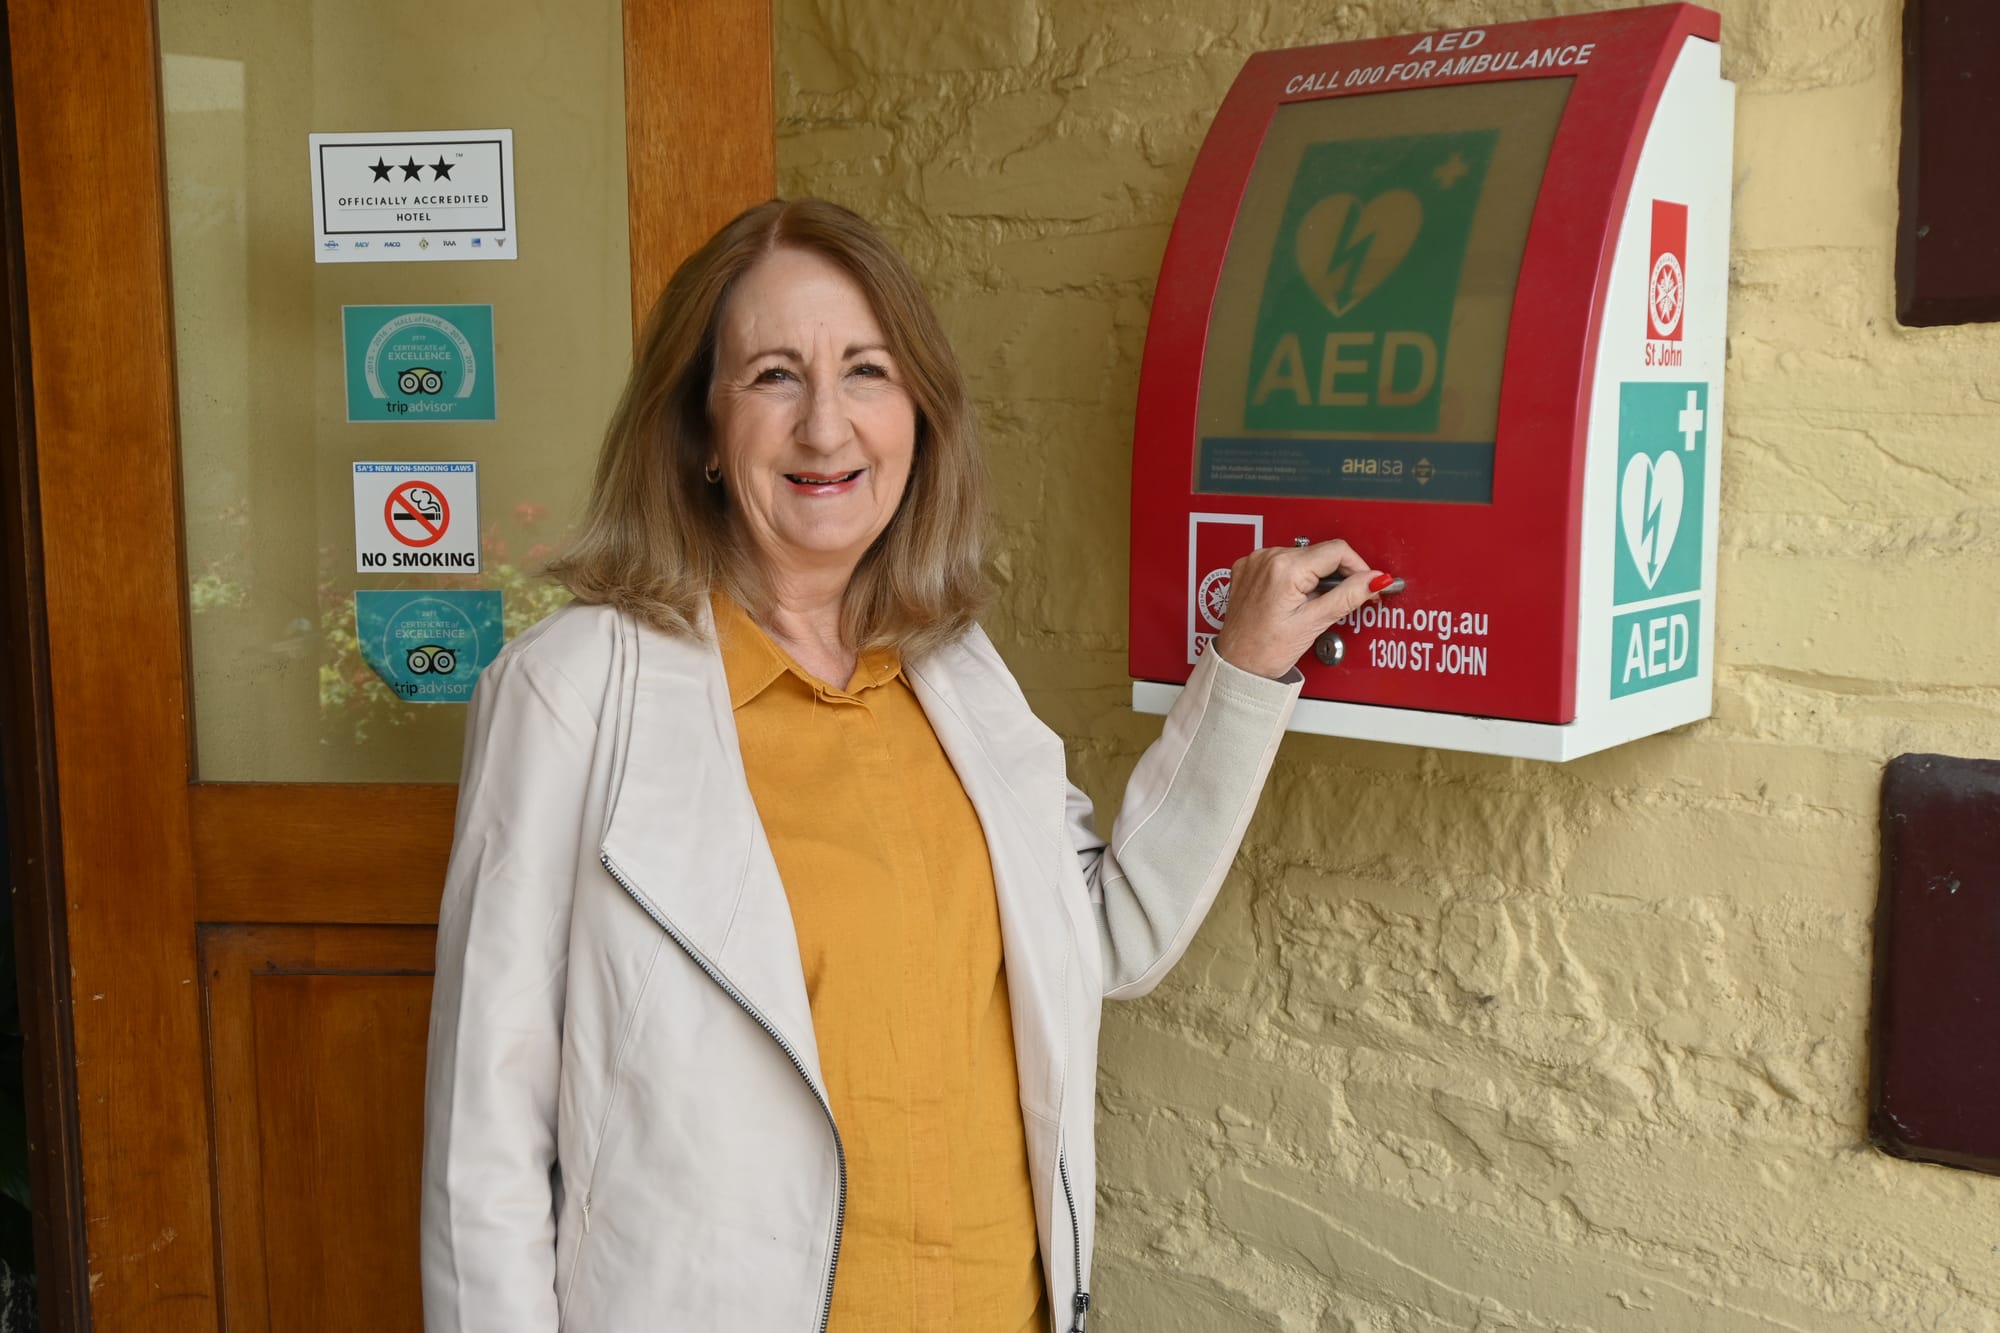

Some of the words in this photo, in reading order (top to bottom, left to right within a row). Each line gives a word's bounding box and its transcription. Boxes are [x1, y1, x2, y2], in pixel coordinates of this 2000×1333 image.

[1408, 30, 1487, 54] AED
[1285, 69, 1348, 95] CALL
[1344, 65, 1386, 88] 000
[1386, 60, 1438, 83] FOR
[1434, 43, 1597, 77] AMBULANCE
[338, 197, 408, 206] OFFICIALLY
[414, 194, 489, 205] ACCREDITED
[396, 213, 431, 221] HOTEL
[388, 352, 451, 360] EXCELLENCE
[1645, 342, 1657, 367] St
[1658, 340, 1682, 367] John
[1252, 331, 1438, 406] AED
[386, 401, 453, 415] tripadvisor
[361, 553, 387, 567] NO
[392, 552, 475, 567] SMOKING
[401, 621, 450, 629] CERTIFICATE
[395, 629, 465, 638] EXCELLENCE
[1622, 613, 1689, 684] AED
[1368, 638, 1407, 670] 1300
[1410, 641, 1434, 672] ST
[1436, 643, 1488, 676] JOHN
[394, 681, 467, 696] tripadvisor
